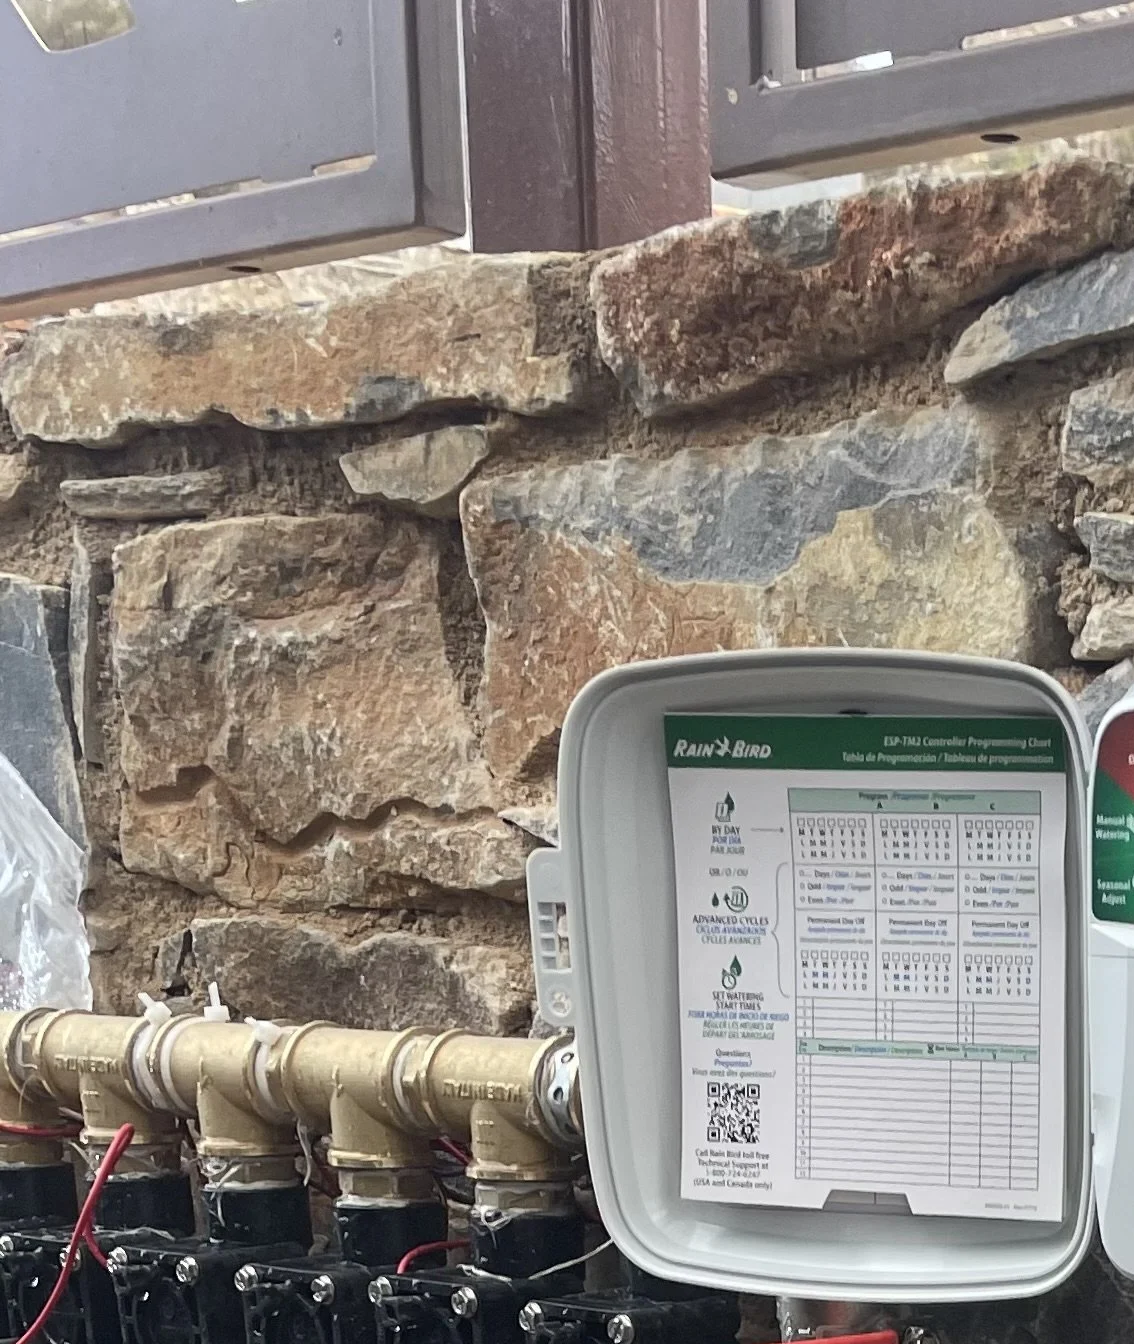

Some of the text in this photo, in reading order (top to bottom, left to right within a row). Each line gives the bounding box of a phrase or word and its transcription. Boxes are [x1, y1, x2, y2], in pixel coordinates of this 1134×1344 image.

[673, 739, 772, 758] RAIN BIRD
[884, 736, 1051, 750] ESP-TM2 Controller Programming Chart
[842, 752, 864, 762] Tabla
[866, 752, 876, 762] de
[944, 753, 976, 763] Tableau
[978, 754, 987, 764] de
[989, 754, 1053, 766] programmation
[1096, 814, 1125, 825] Manual
[724, 826, 740, 835] DAY
[1095, 828, 1130, 842] Watering
[1097, 879, 1131, 891] Seasonal
[1102, 892, 1126, 905] Adjust
[692, 915, 769, 925] ADVANCED CYCLES
[712, 991, 764, 1001] SET WATERING
[716, 1001, 761, 1011] START TIMES
[710, 1149, 726, 1157] Rain
[726, 1150, 741, 1158] Bird
[755, 1150, 770, 1160] free
[698, 1159, 731, 1168] Technical
[732, 1160, 760, 1170] Support
[712, 1179, 726, 1188] and
[726, 1180, 753, 1188] Canada
